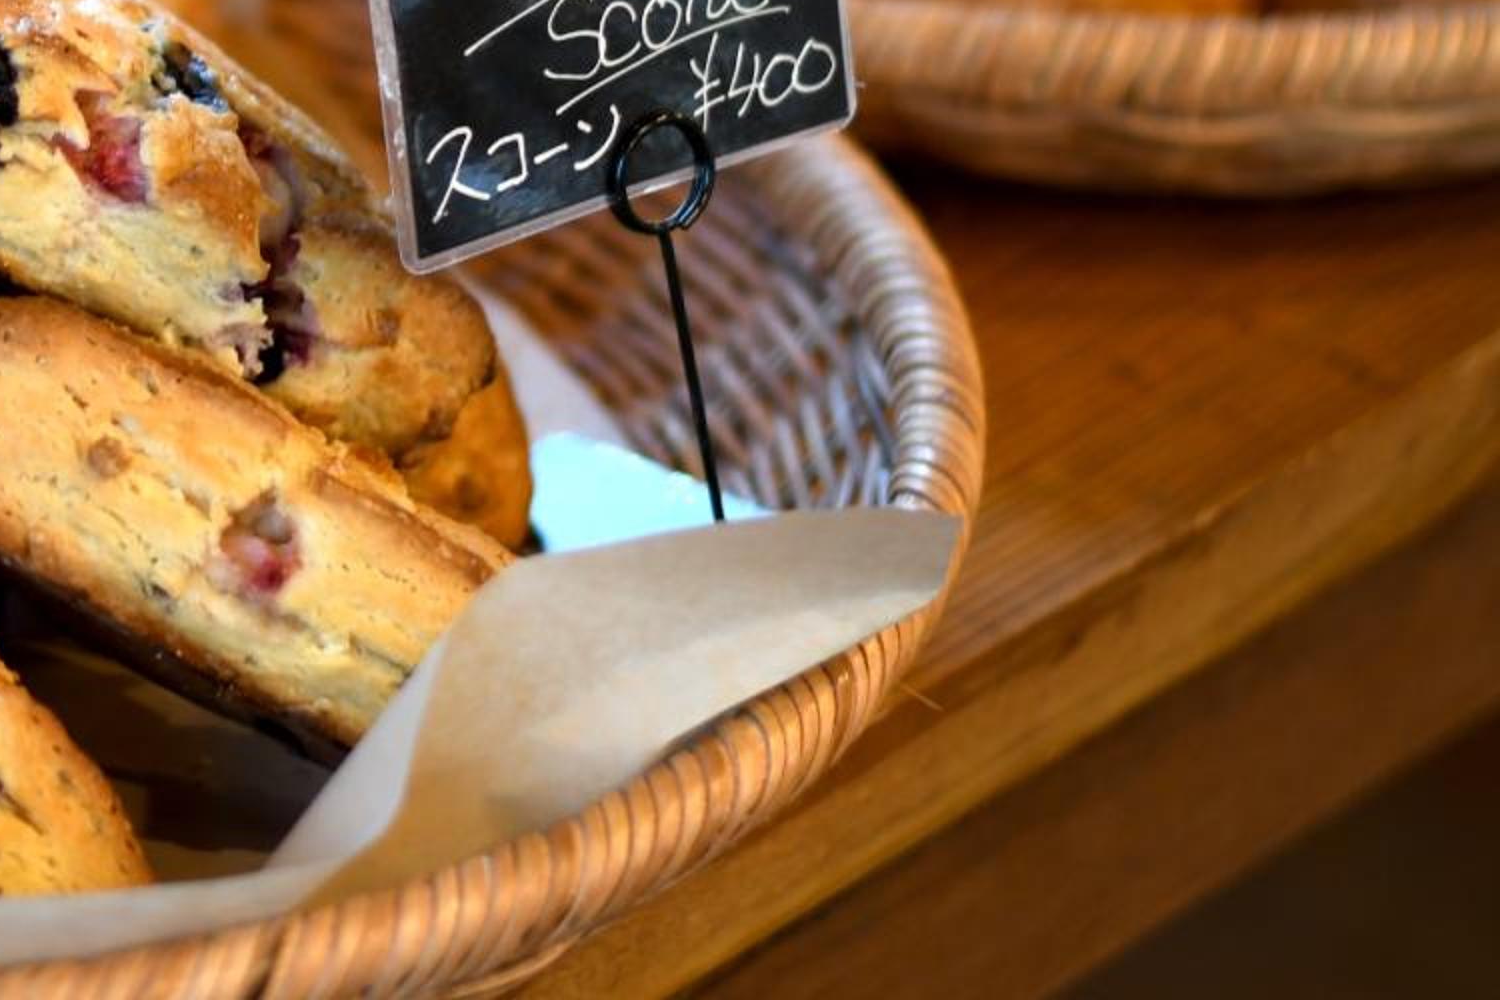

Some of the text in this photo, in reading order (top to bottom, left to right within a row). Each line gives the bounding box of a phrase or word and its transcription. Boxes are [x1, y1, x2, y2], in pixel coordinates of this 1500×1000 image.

[691, 32, 835, 131] ¥400
[426, 104, 620, 223] スコーン
